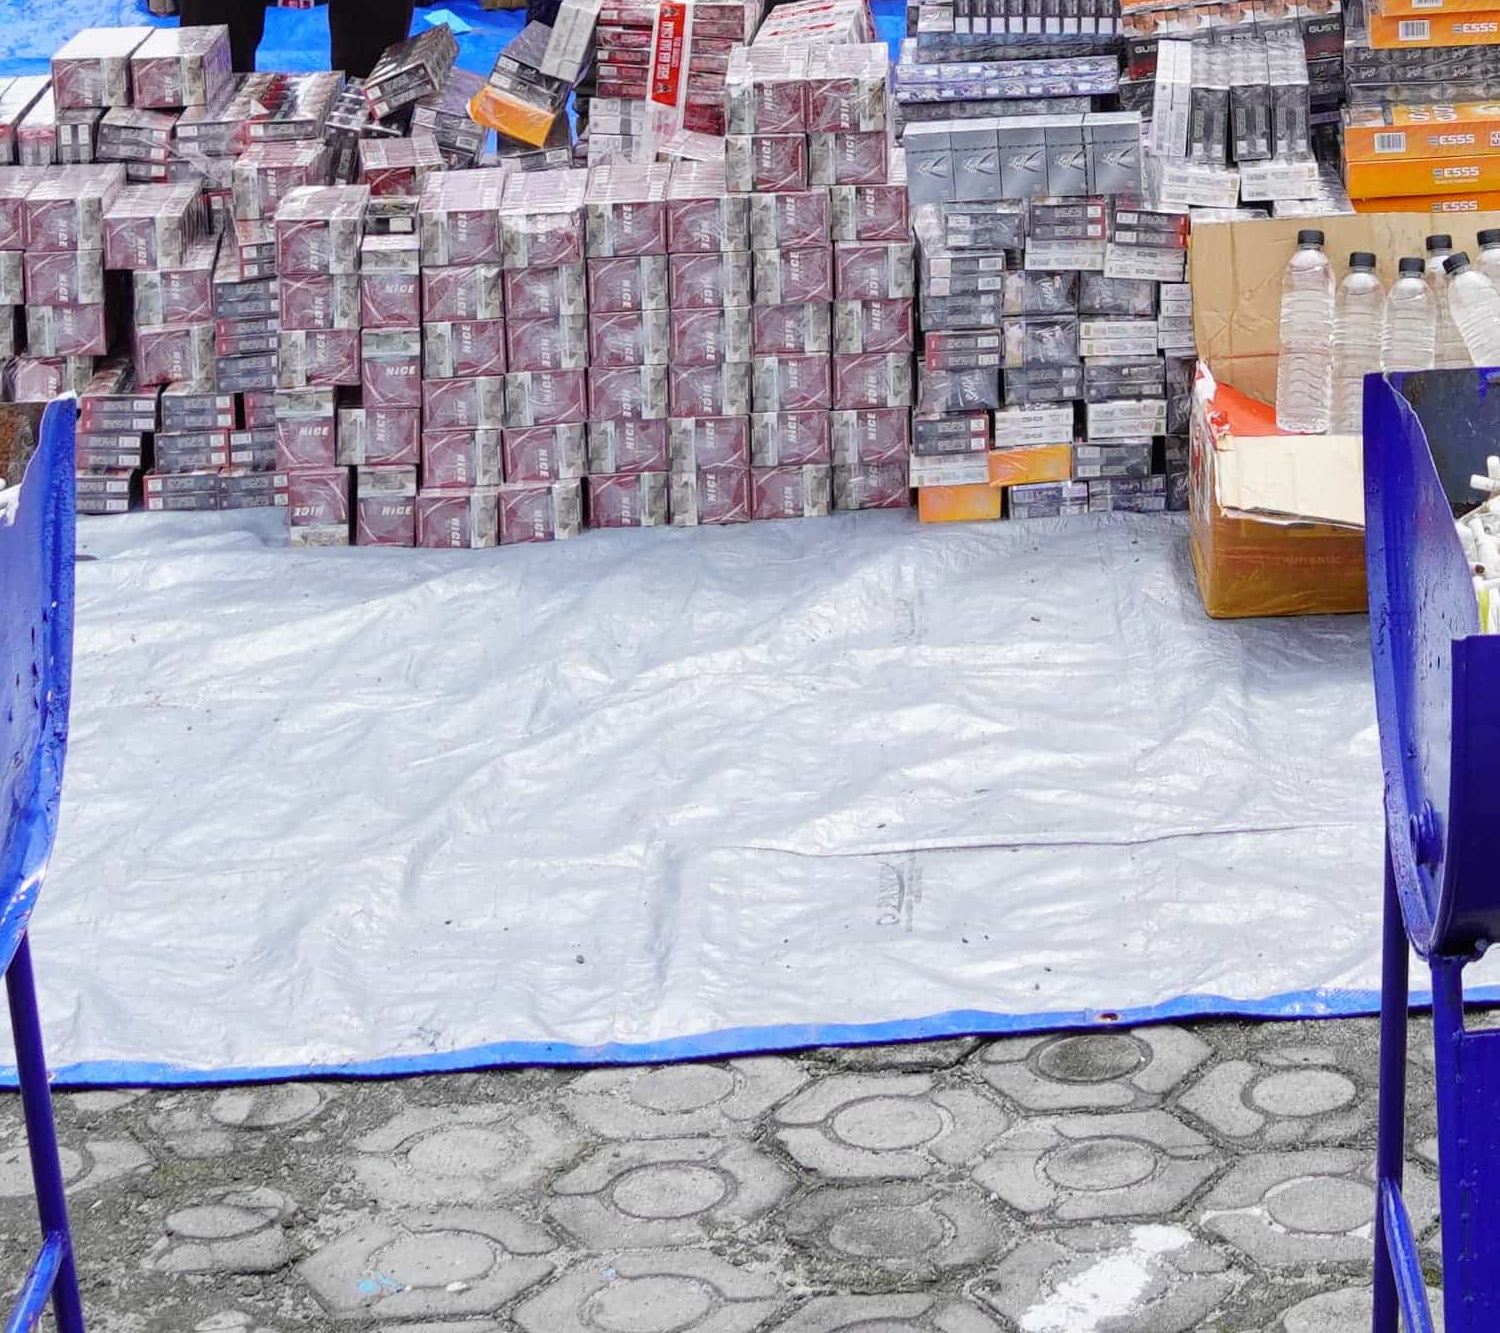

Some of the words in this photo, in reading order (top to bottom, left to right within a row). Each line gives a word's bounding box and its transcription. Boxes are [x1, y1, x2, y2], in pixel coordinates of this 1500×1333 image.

[762, 138, 773, 168] NICE
[845, 134, 855, 162] NICE
[787, 196, 797, 225] NICE
[866, 187, 876, 216] NICE
[622, 204, 632, 234] NICE
[790, 251, 800, 282] NICE
[386, 285, 415, 294] NICE
[622, 279, 632, 309] NICE
[871, 301, 882, 331] NICE
[462, 324, 472, 354] NICE
[706, 331, 716, 361] NICE
[387, 365, 416, 374] NICE
[788, 360, 798, 389] NICE
[702, 384, 713, 414] NICE
[299, 426, 329, 436] NICE
[626, 420, 636, 451] NICE
[787, 413, 797, 443] NICE
[868, 412, 878, 441] NICE
[457, 453, 467, 482] NICE
[539, 448, 549, 477] NICE
[707, 472, 718, 502] NICE
[382, 505, 413, 515] NICE
